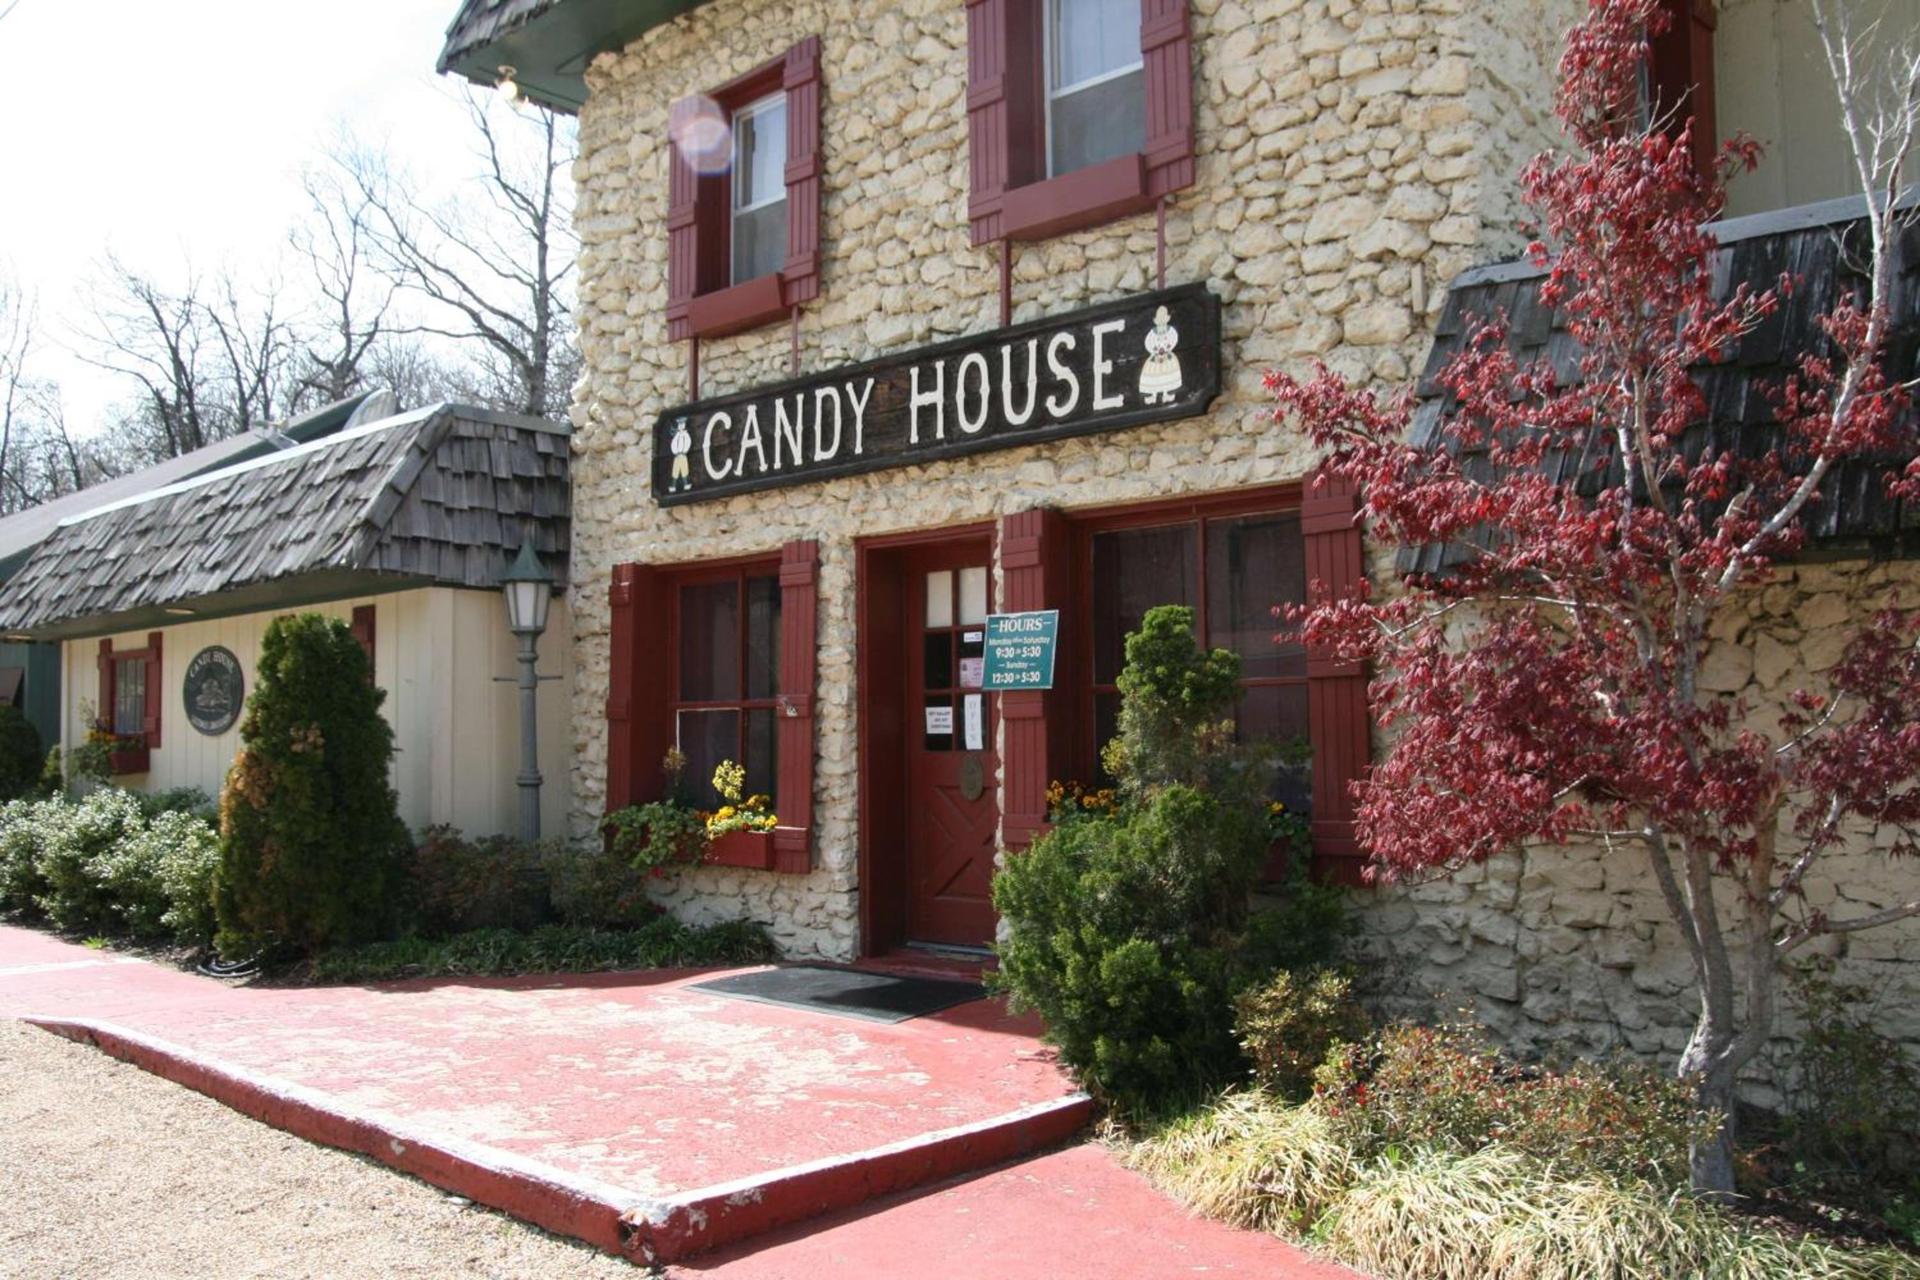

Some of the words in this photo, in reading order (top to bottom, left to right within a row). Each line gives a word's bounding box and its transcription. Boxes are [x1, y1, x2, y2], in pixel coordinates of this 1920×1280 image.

[703, 377, 875, 480] CANDY
[909, 318, 1126, 444] HOUSE
[998, 617, 1043, 633] HOURS
[988, 638, 1012, 646] Monday
[1023, 636, 1051, 645] Saturday
[995, 647, 1015, 658] 9:30
[1021, 646, 1042, 658] 5:30
[1006, 661, 1028, 669] Sunday
[992, 672, 1015, 684] 12:30
[1020, 671, 1041, 682] 5:30
